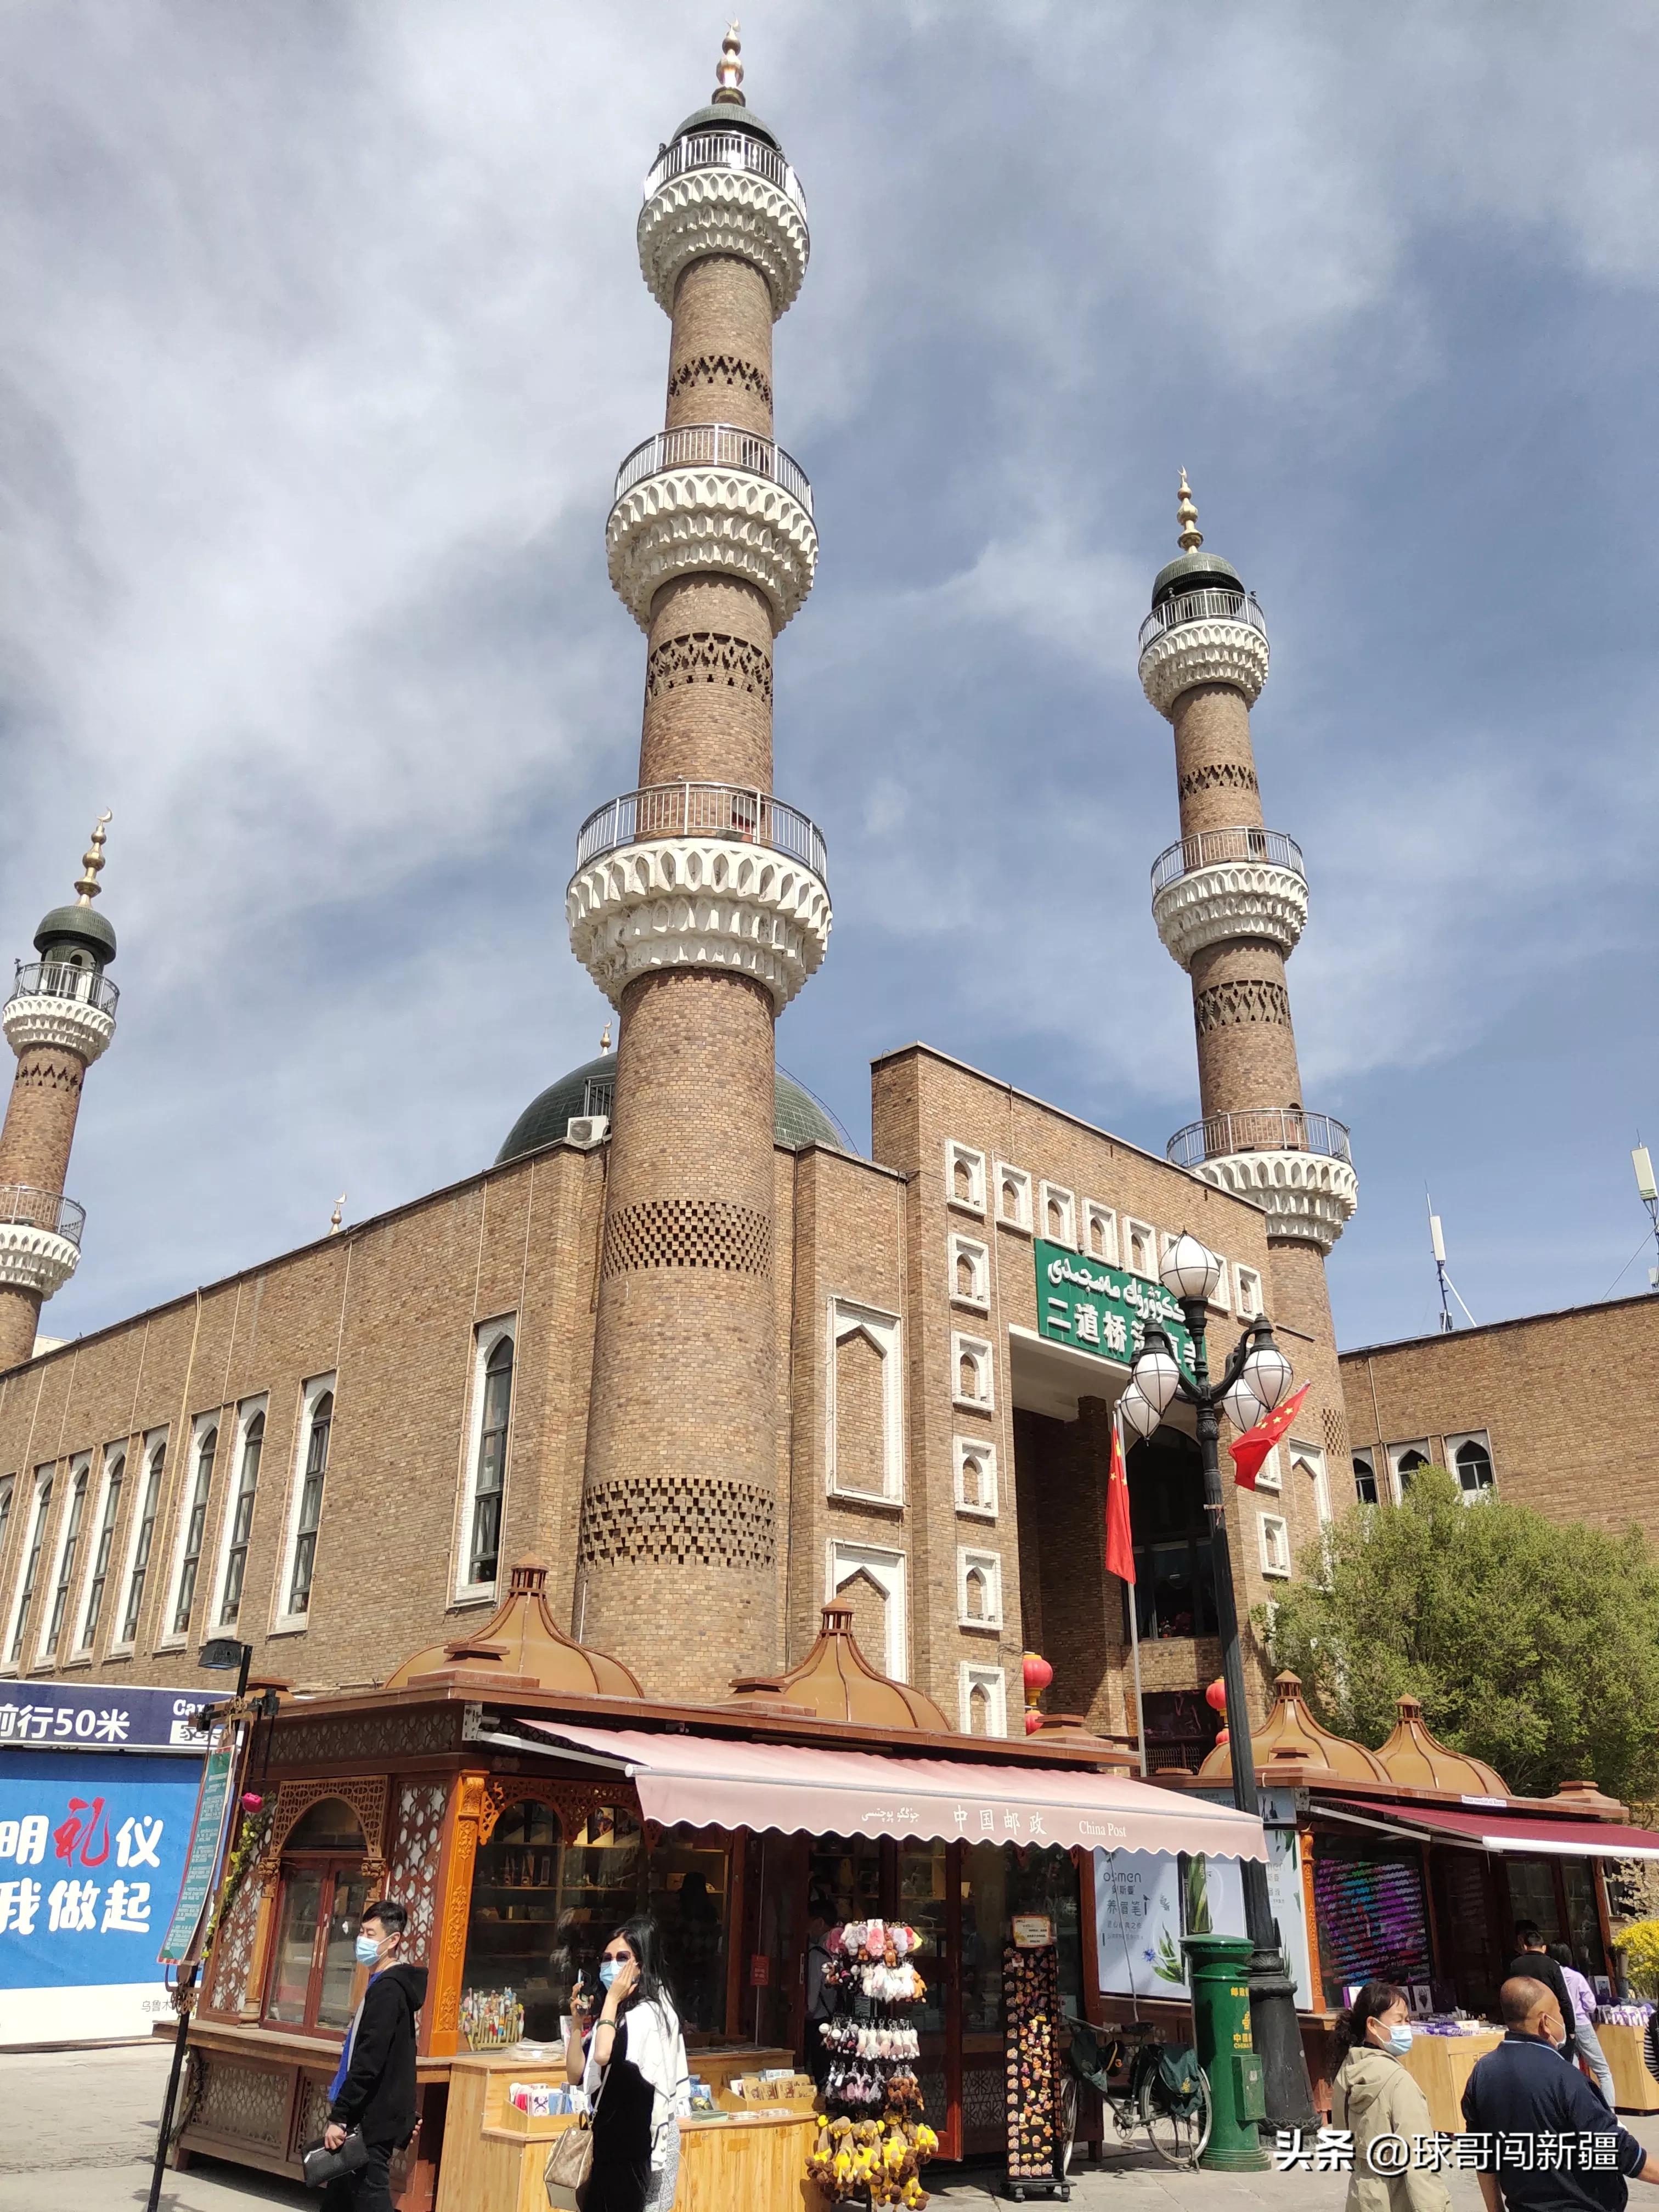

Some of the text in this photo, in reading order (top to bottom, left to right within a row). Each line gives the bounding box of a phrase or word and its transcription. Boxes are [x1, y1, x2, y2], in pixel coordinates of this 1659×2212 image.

[0, 1703, 131, 1742] 前行50米
[953, 1804, 1047, 1836] 中国邮政
[1079, 1819, 1127, 1838] China Post
[0, 1877, 151, 1935] 我做起
[140, 1999, 172, 2012] 乌鲁木
